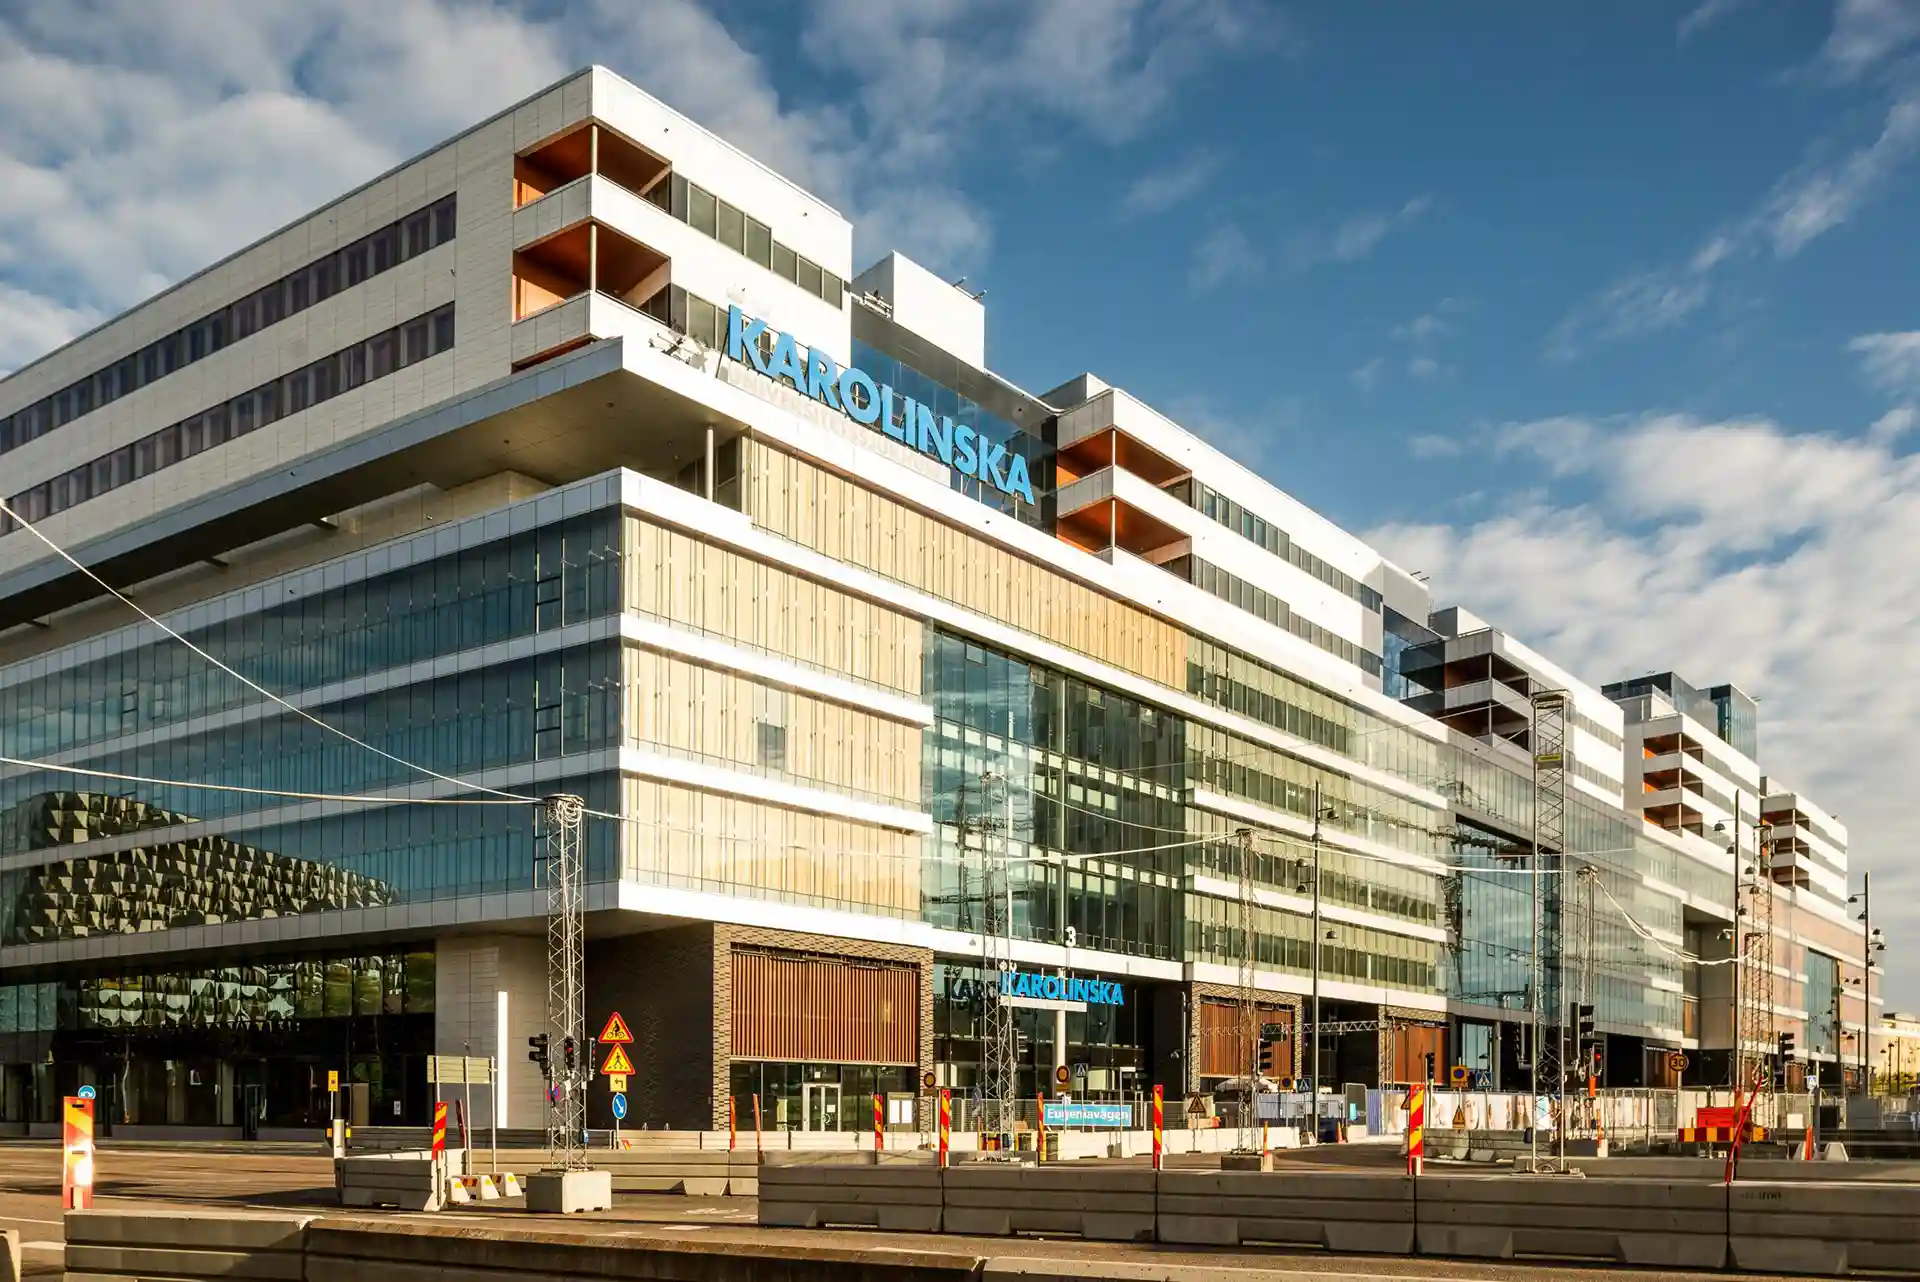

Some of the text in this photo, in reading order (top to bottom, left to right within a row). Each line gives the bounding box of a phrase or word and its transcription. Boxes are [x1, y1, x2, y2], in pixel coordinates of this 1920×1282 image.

[729, 304, 1034, 505] KAROLINSKA
[1065, 926, 1076, 946] 3
[1001, 972, 1124, 1005] KAROLINSKA
[1671, 1058, 1685, 1068] 30
